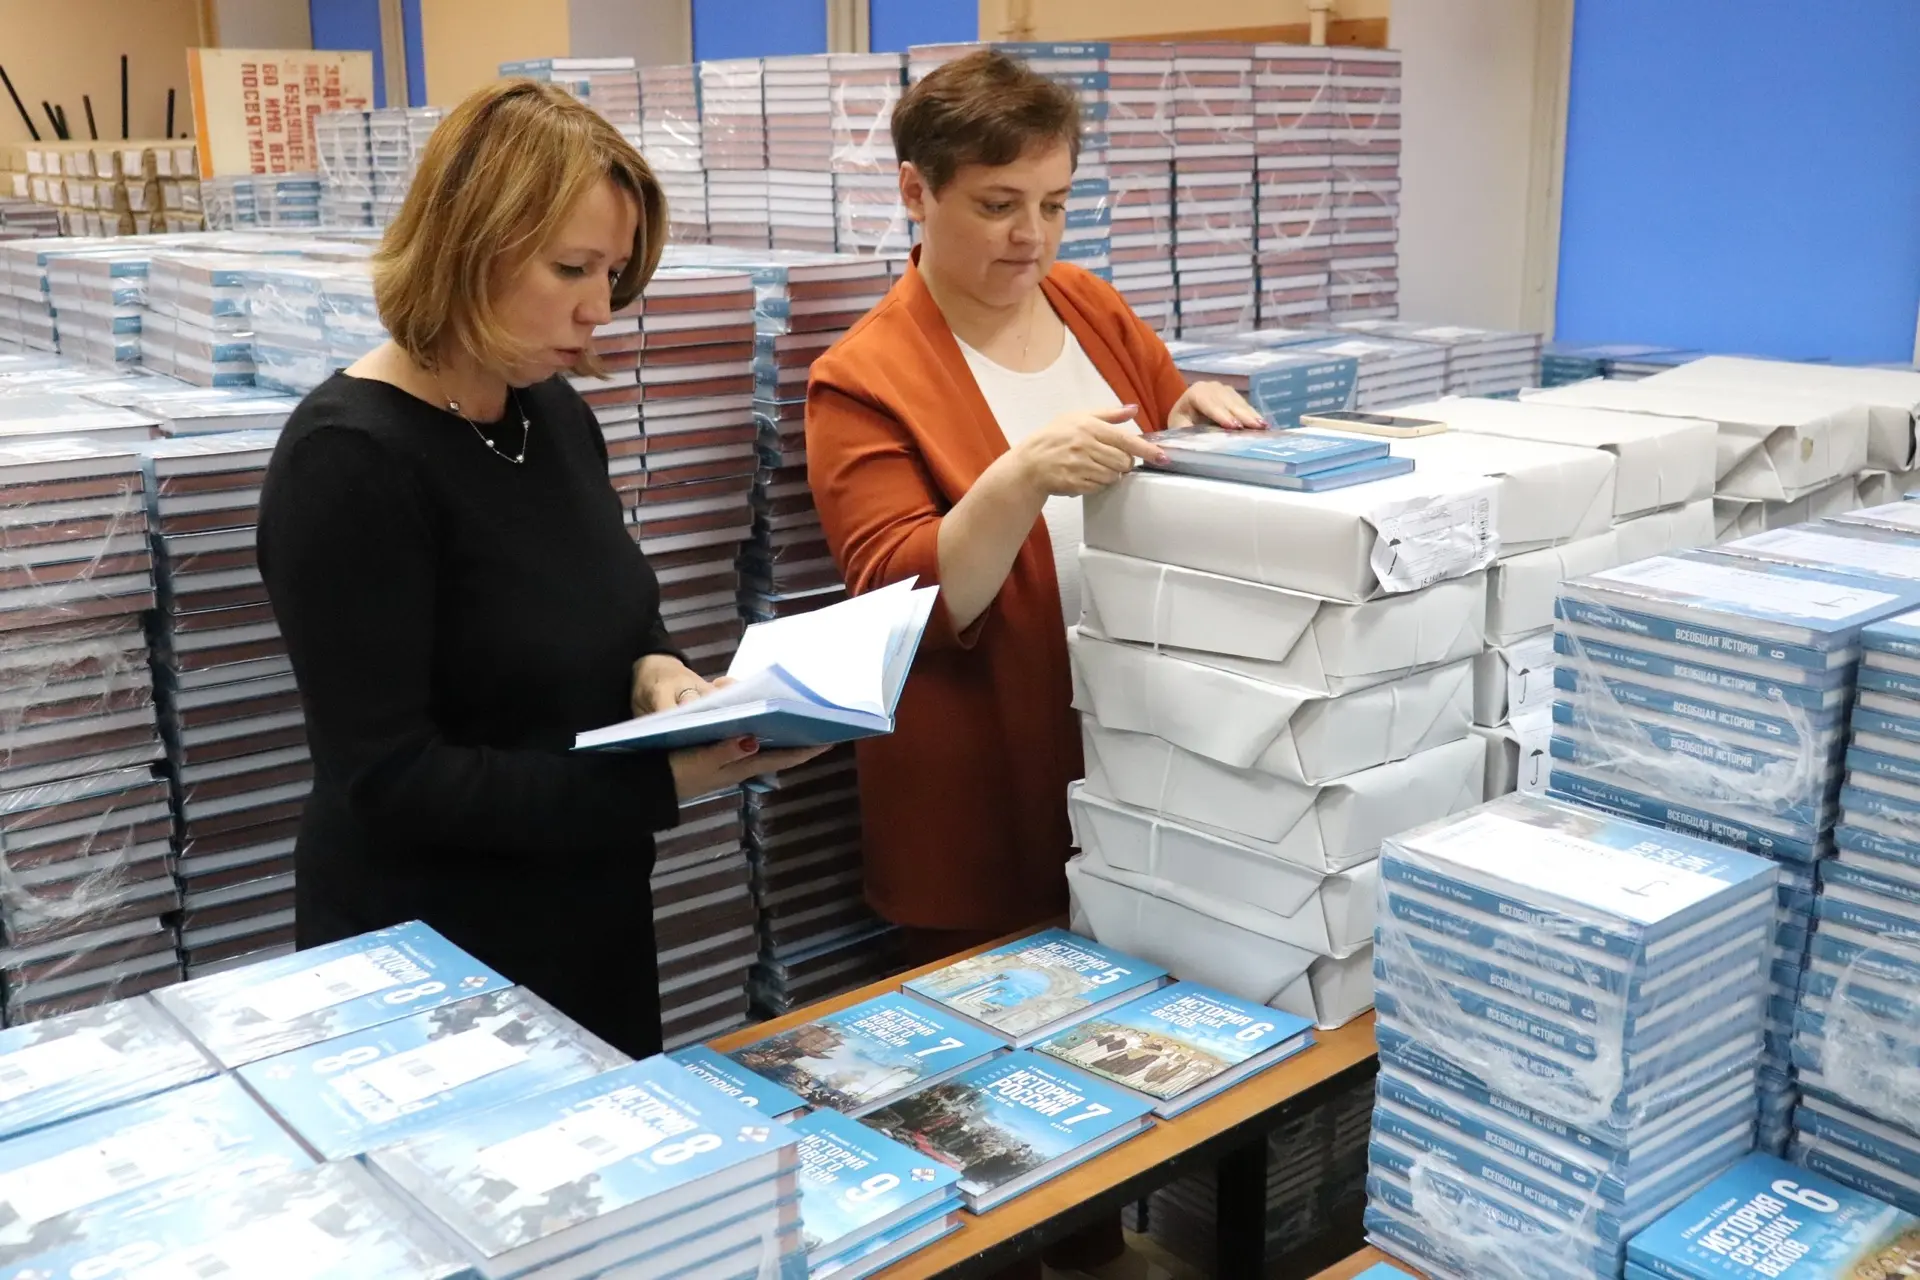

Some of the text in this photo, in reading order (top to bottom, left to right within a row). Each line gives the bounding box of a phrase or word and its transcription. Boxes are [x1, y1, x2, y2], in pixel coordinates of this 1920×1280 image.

[1675, 628, 1719, 649] ВСЕОБЩАЯ
[1721, 637, 1759, 656] ИСТОРИЯ
[1673, 664, 1718, 685] ВСЕОБЩАЯ
[1720, 673, 1756, 693] ИСТОРИЯ
[1673, 701, 1717, 721] ВСЕОБЩАЯ
[1719, 710, 1755, 731] ИСТОРИЯ
[1671, 738, 1752, 768] ВСЕОБЩАЯ ИСТОРИЯ
[1667, 809, 1709, 831] ВСЕОБЩАЯ
[1711, 819, 1748, 841] ИСТОРИЯ
[1031, 948, 1132, 985] ДРЕВНЕГО 5
[1042, 942, 1110, 971] ИСТОРИЯ
[383, 981, 447, 1005] 8
[880, 1009, 938, 1038] ИСТОРИЯ
[1151, 1009, 1198, 1028] ВЕКОВ
[1163, 1004, 1275, 1042] СРЕДНИХ 6
[1175, 996, 1254, 1026] ИСТОРИЯ
[852, 1019, 911, 1048] ВРЕМЕНИ
[866, 1013, 917, 1039] НОВОГО
[915, 1037, 966, 1058] 7
[311, 1046, 381, 1075] 8
[987, 1078, 1071, 1117] РОССИИ
[1062, 1102, 1113, 1126] 7
[1006, 1070, 1087, 1107] ИСТОРИЯ
[1489, 1095, 1530, 1120] ВСЕОБЩАЯ
[1532, 1112, 1567, 1137] ИСТОРИЯ
[650, 1133, 723, 1166] 8
[802, 1133, 870, 1171] ИСТОРИЯ
[1485, 1130, 1526, 1156] ВСЕОБЩАЯ
[1527, 1149, 1562, 1174] ИСТОРИЯ
[845, 1172, 901, 1202] 9
[1481, 1165, 1522, 1193] ВСЕОБЩАЯ
[1771, 1179, 1840, 1213] 6
[1697, 1192, 1789, 1256] ИСТОРИЯ
[1729, 1213, 1805, 1267] СРЕДНИХ
[1752, 1238, 1811, 1279] ВЕКОВ
